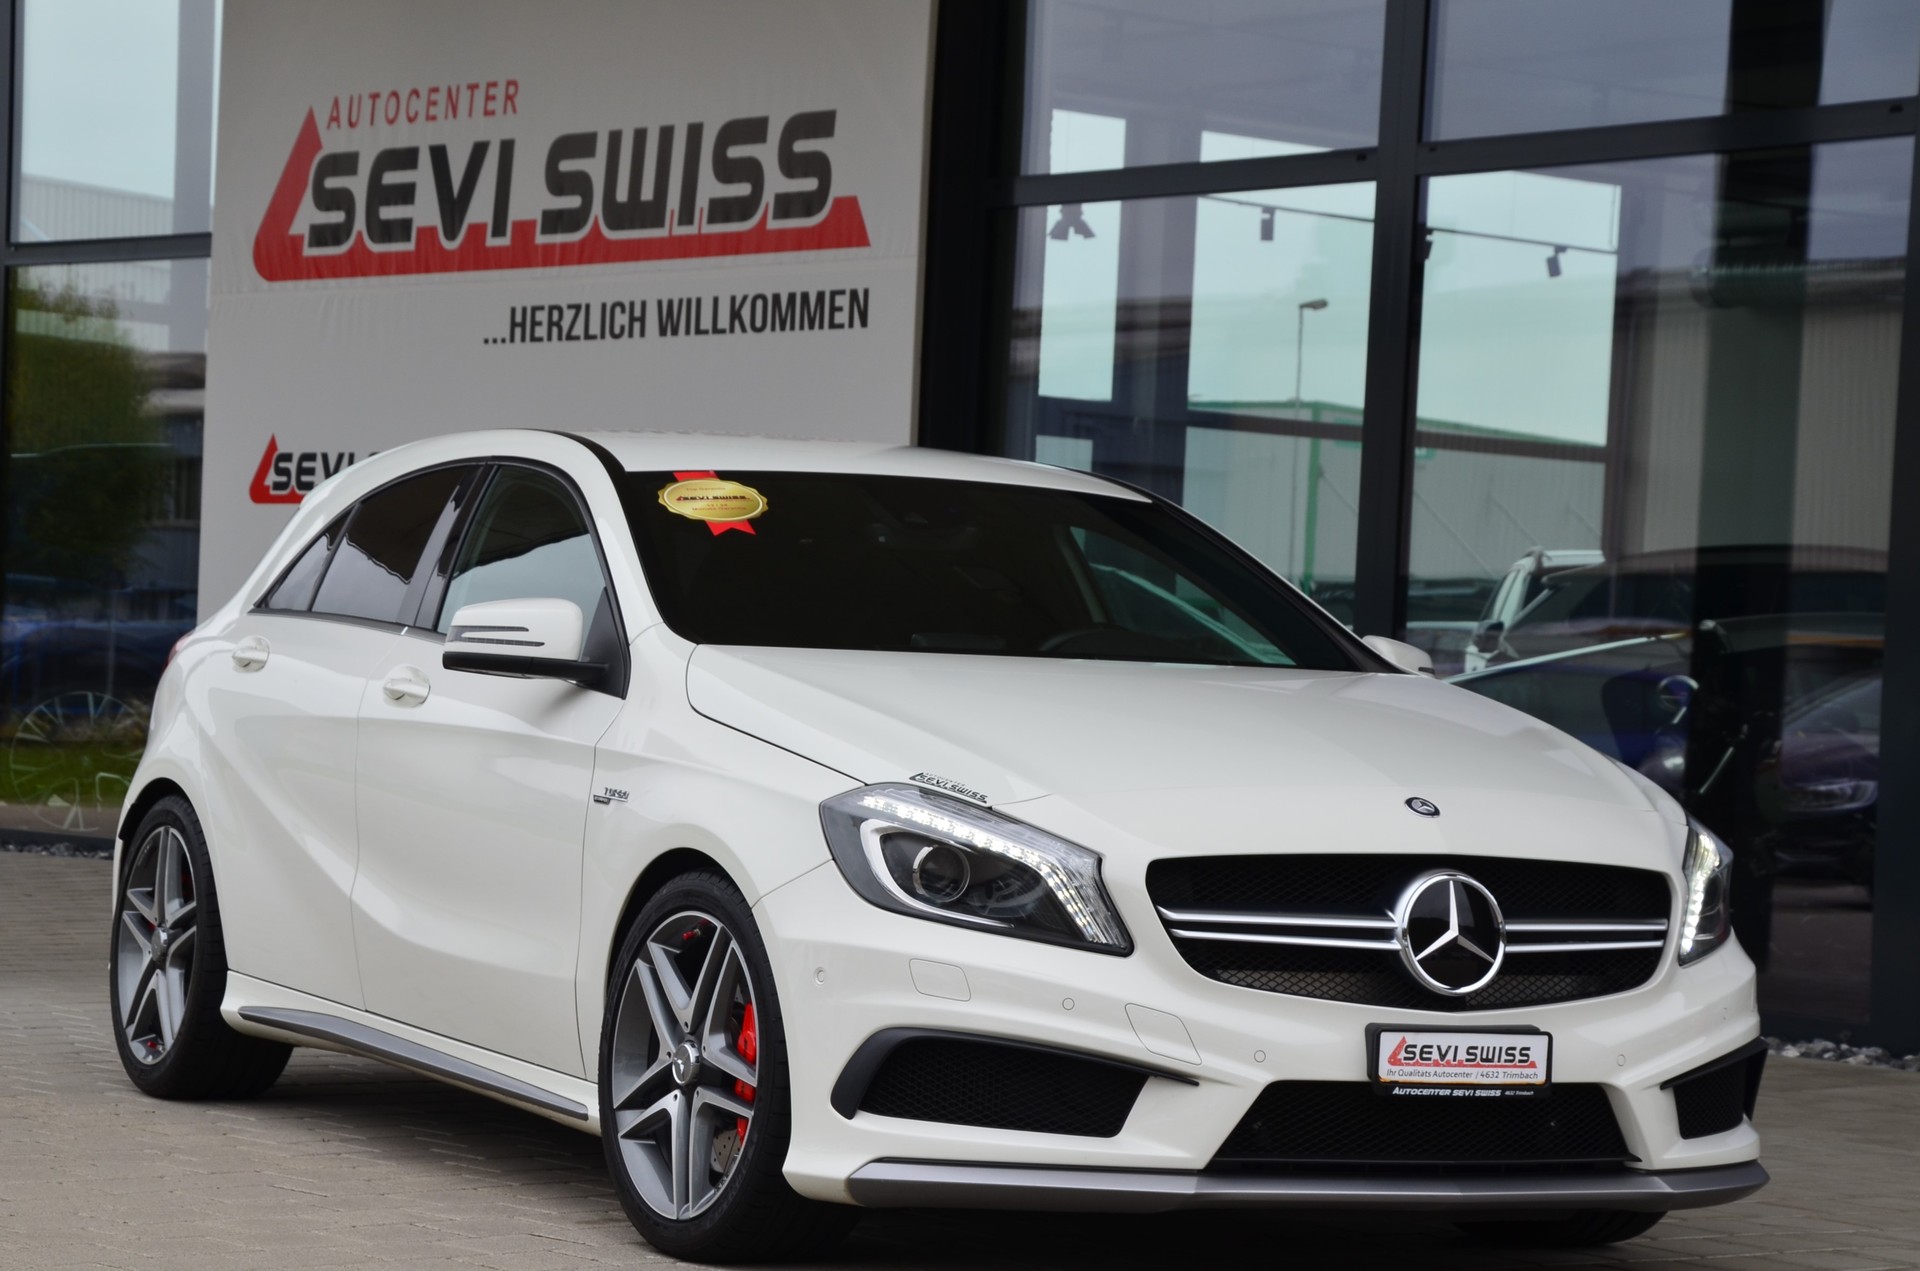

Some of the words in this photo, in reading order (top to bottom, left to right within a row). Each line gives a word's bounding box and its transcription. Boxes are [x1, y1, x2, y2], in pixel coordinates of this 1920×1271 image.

[326, 78, 520, 130] AUTOCENTER
[303, 138, 516, 251] SEVI
[536, 108, 838, 237] SWISS
[656, 287, 870, 338] WILLKOMMEN
[917, 774, 948, 787] SEVI
[948, 783, 988, 801] SWISS
[1403, 1044, 1459, 1063] SEVI
[1465, 1045, 1532, 1064] SWISS
[1387, 1068, 1397, 1077] Ihr
[1432, 1069, 1473, 1079] Autocenter
[1480, 1070, 1500, 1079] 4632
[1502, 1070, 1538, 1080] Trimbach
[1452, 1088, 1475, 1097] SEVI
[1475, 1089, 1502, 1097] SWISS
